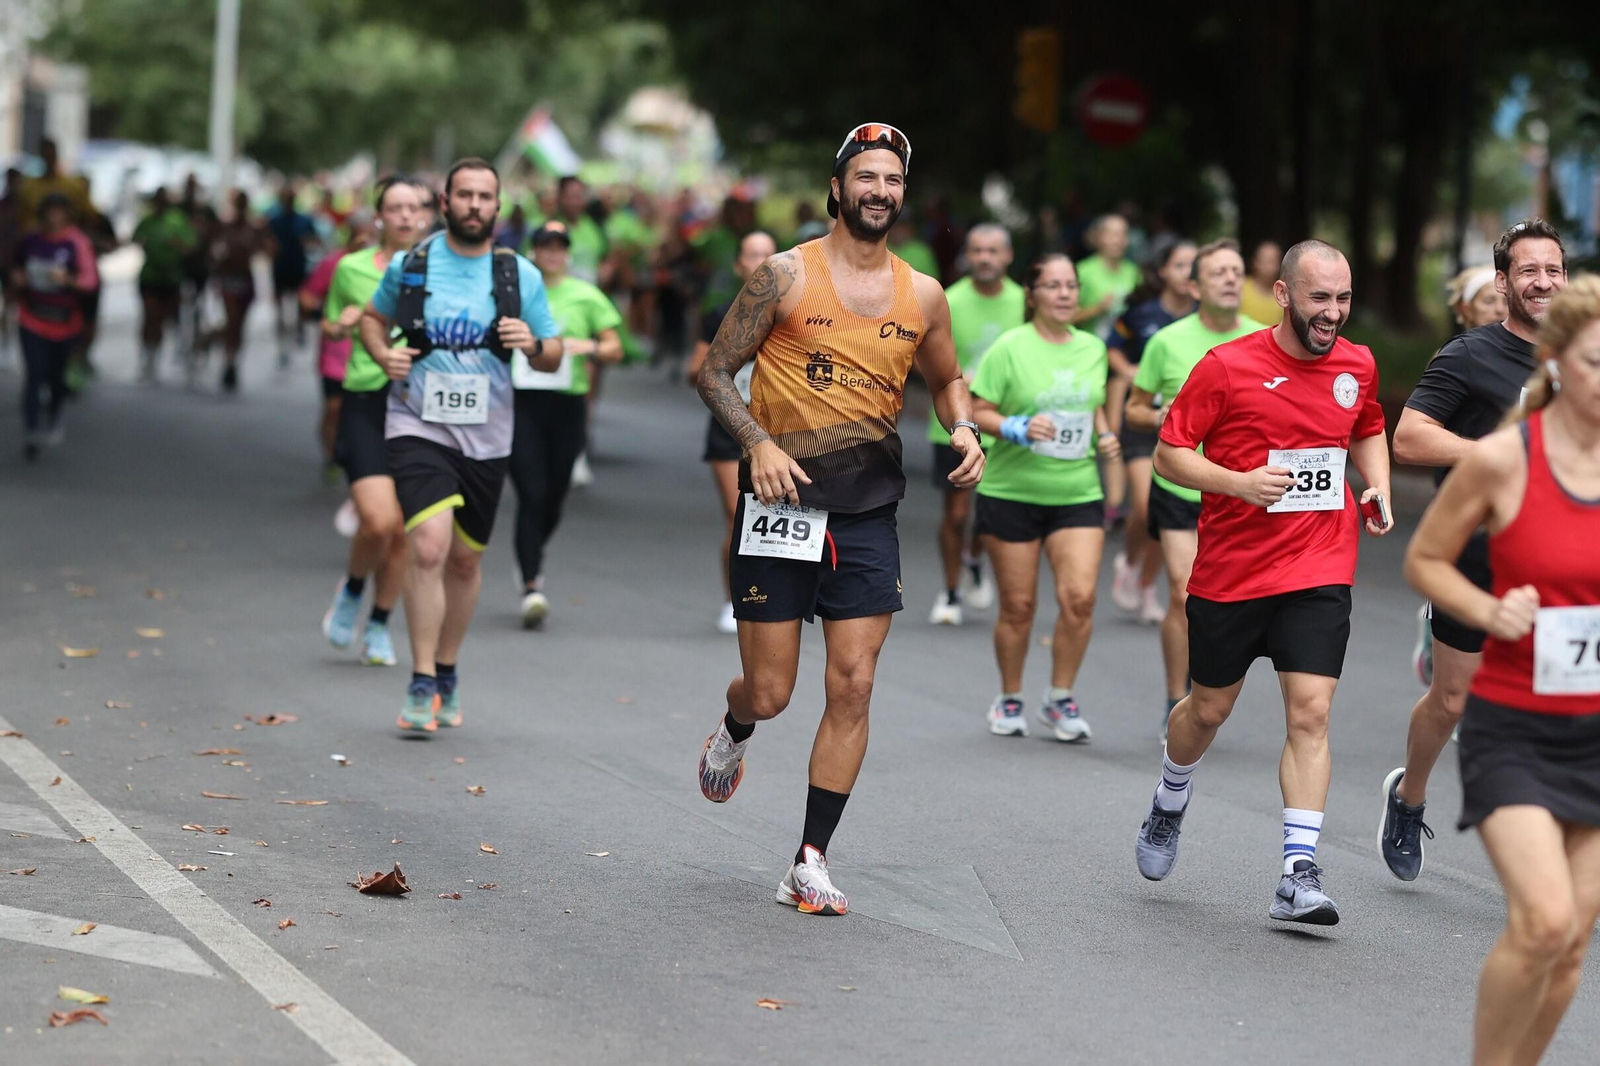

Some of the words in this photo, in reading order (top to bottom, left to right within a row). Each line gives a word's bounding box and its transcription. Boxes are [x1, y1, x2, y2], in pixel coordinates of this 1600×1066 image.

[805, 314, 833, 328] vive
[434, 391, 478, 408] 196
[751, 515, 811, 541] 449
[1568, 640, 1600, 666] 7
